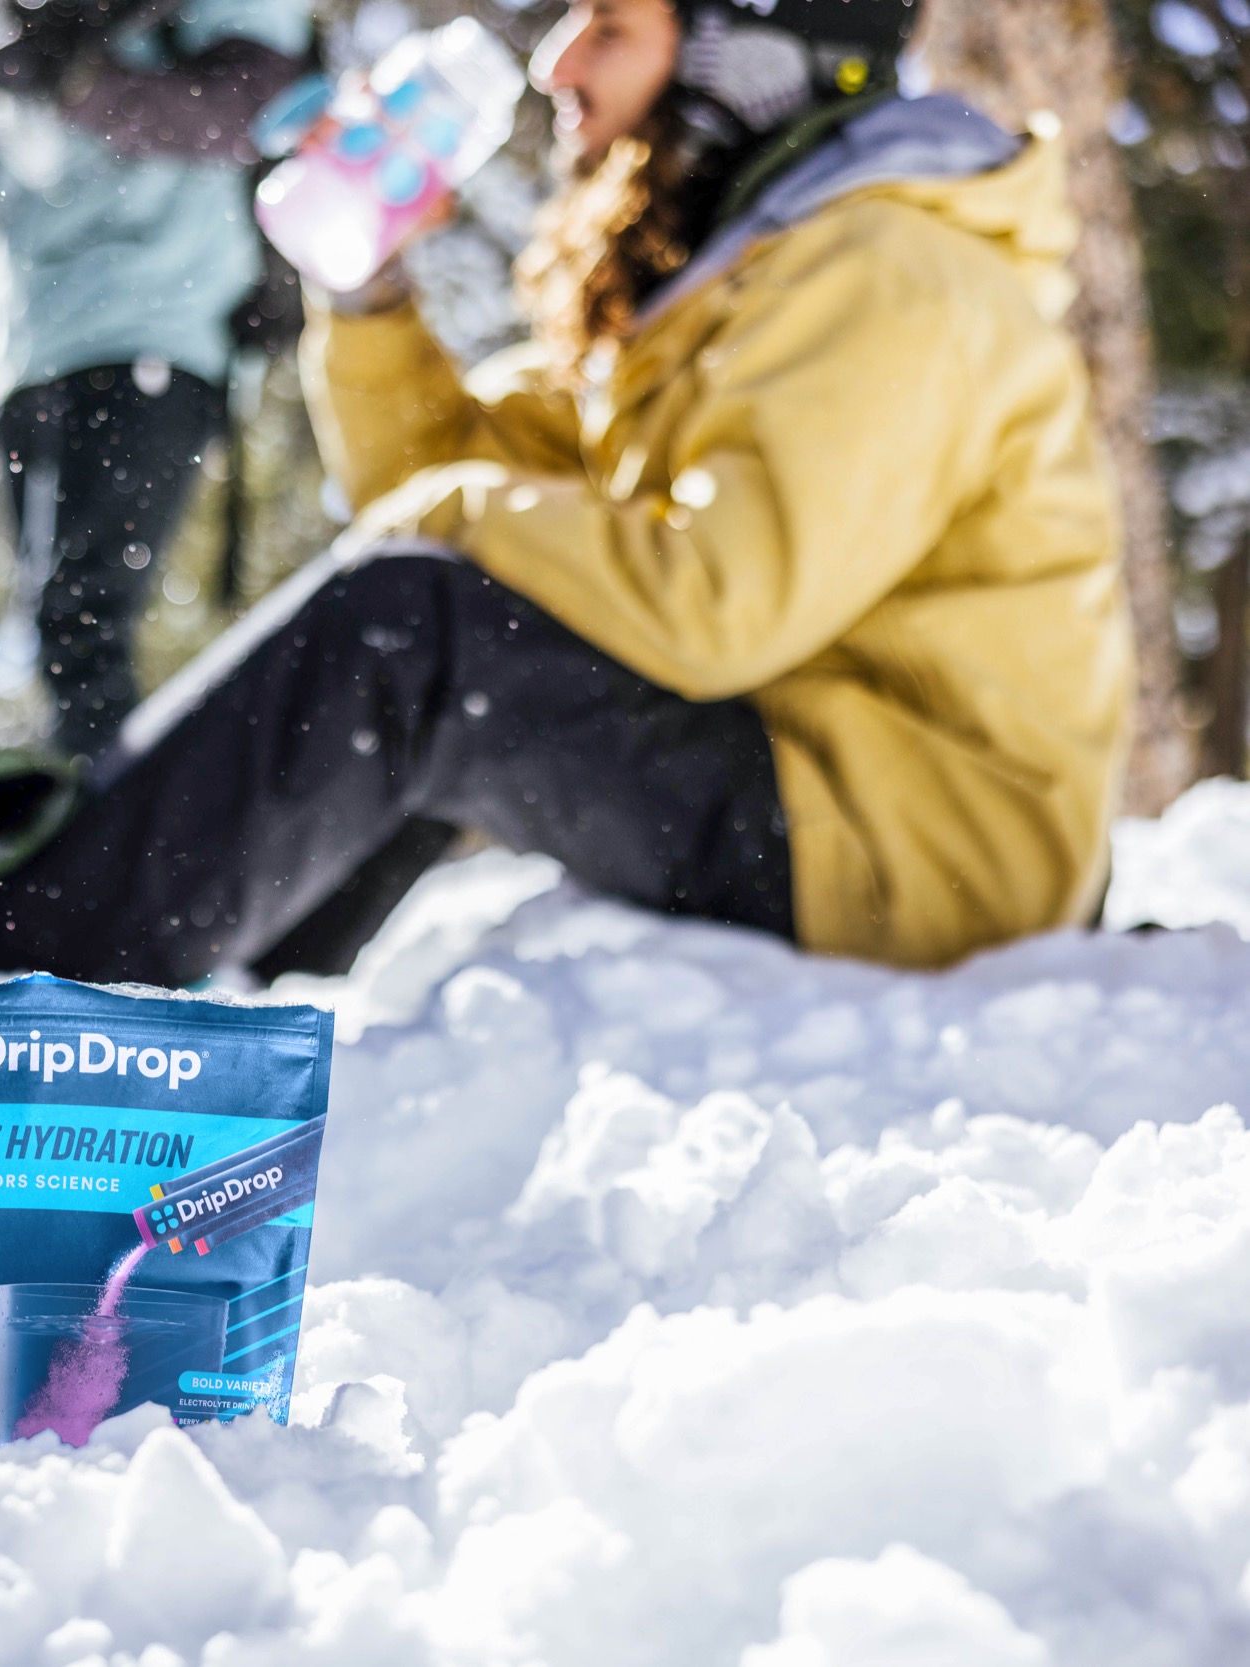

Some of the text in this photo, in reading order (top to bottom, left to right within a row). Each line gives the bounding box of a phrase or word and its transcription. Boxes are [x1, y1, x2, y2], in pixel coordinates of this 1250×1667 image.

[5, 1125, 194, 1169] HYDRATION
[35, 1175, 120, 1192] SCIENCE
[192, 1378, 273, 1393] BOLD VARIETY
[179, 1399, 231, 1409] ELECTROLYTE
